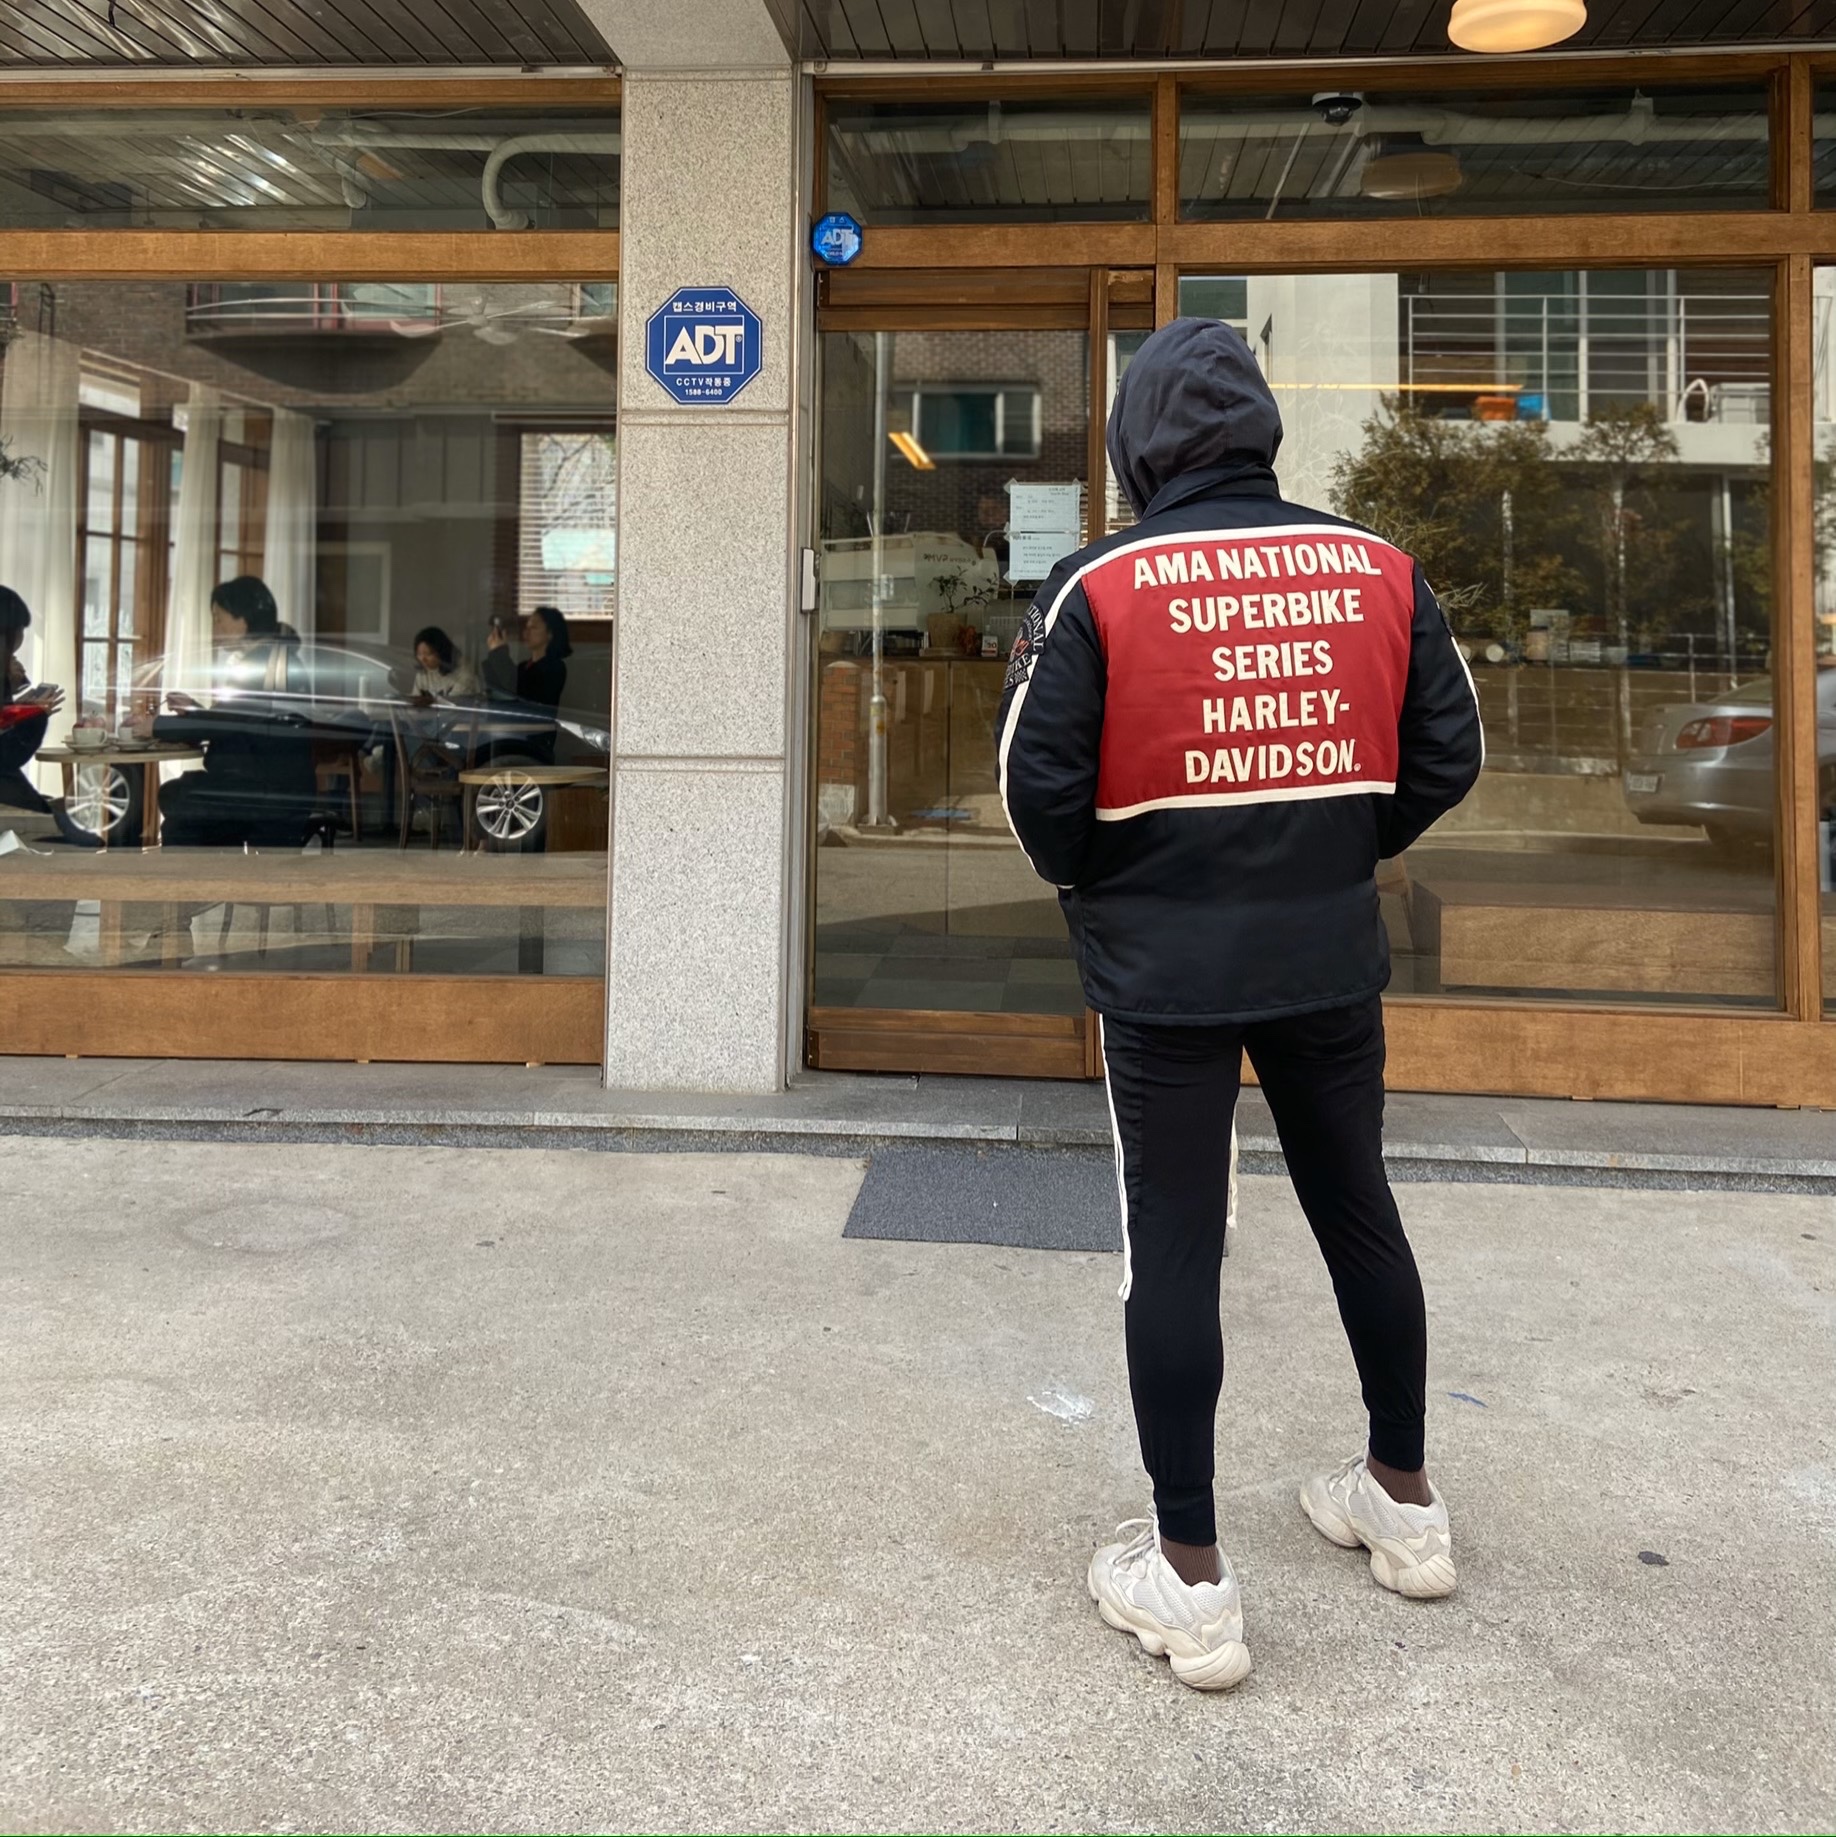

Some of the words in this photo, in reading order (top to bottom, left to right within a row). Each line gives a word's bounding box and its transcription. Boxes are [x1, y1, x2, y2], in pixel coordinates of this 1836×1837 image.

[821, 228, 854, 245] ADT
[673, 301, 737, 313] 캡스경비구역
[685, 388, 723, 396] 1588-6400
[1134, 549, 1215, 590] AMA
[1216, 542, 1382, 580] NATIONAL
[1026, 604, 1045, 652] TIONAL
[1168, 588, 1364, 634] SUPERBIKE
[1211, 640, 1334, 682] SERIES
[1202, 688, 1350, 734] HARLEY-
